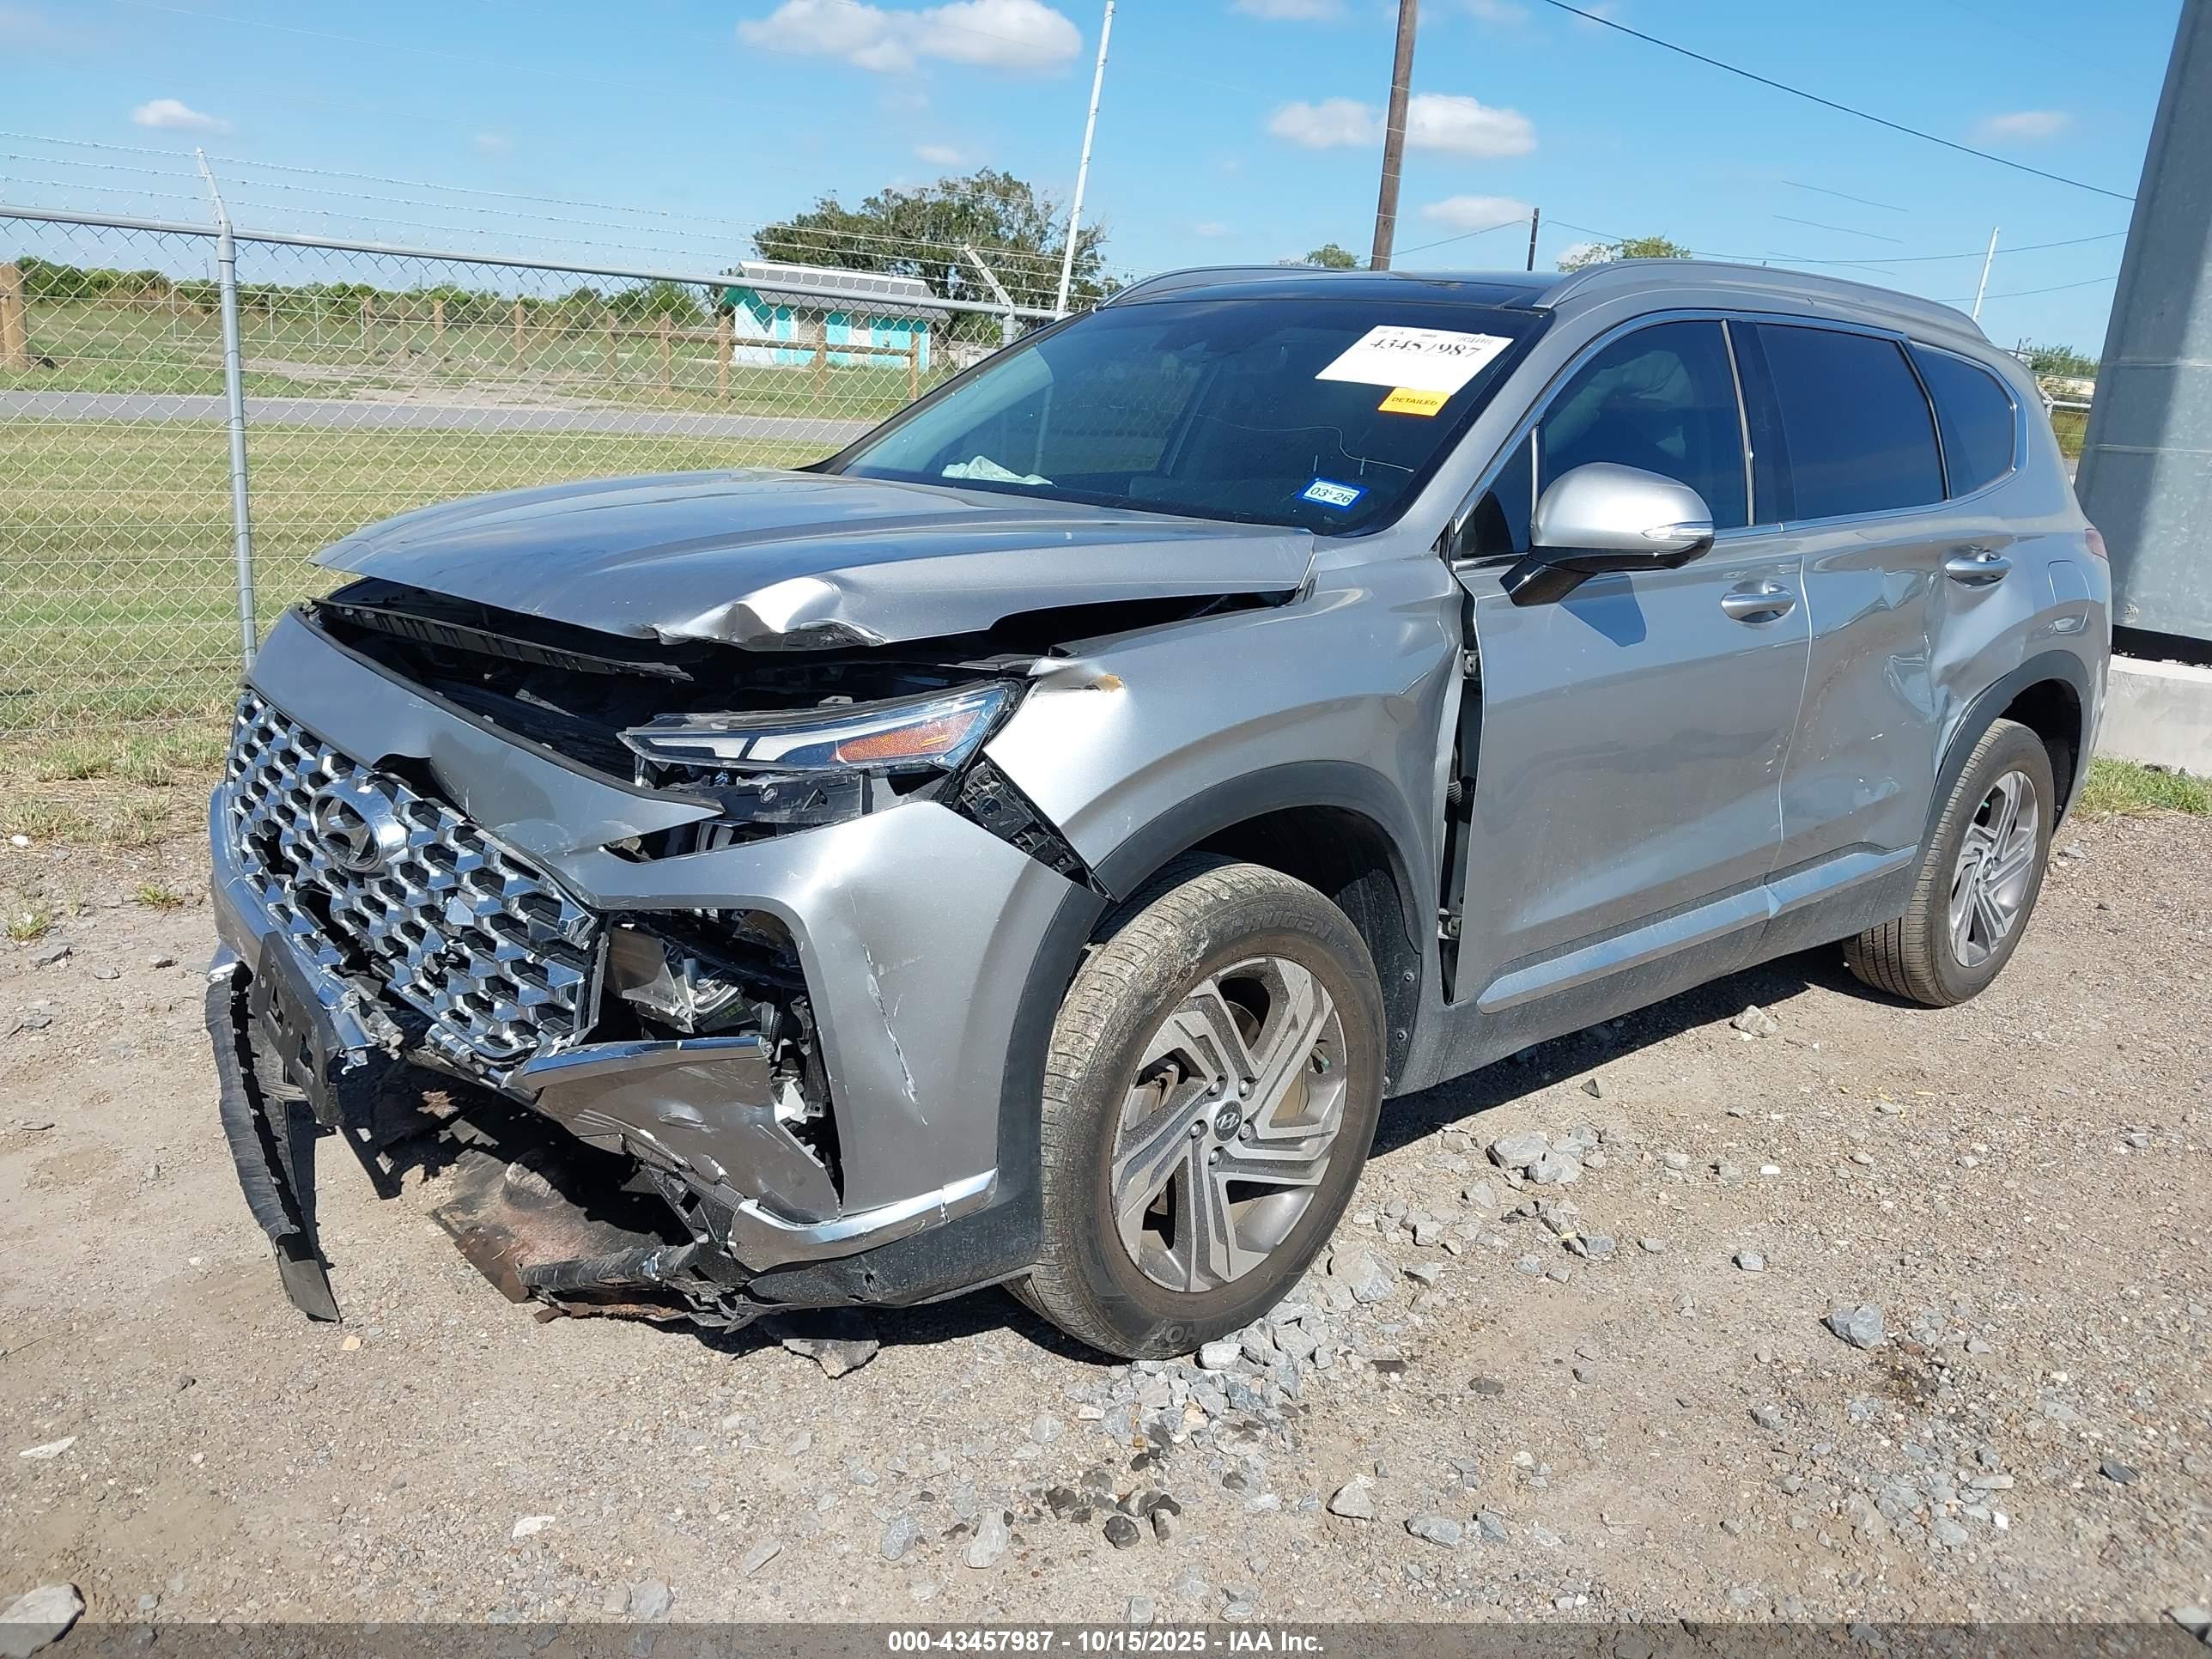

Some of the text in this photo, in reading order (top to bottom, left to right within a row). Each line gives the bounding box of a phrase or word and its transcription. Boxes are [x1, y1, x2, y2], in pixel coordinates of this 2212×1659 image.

[1390, 395, 1438, 407] DETAILED
[1310, 487, 1353, 503] 03 26
